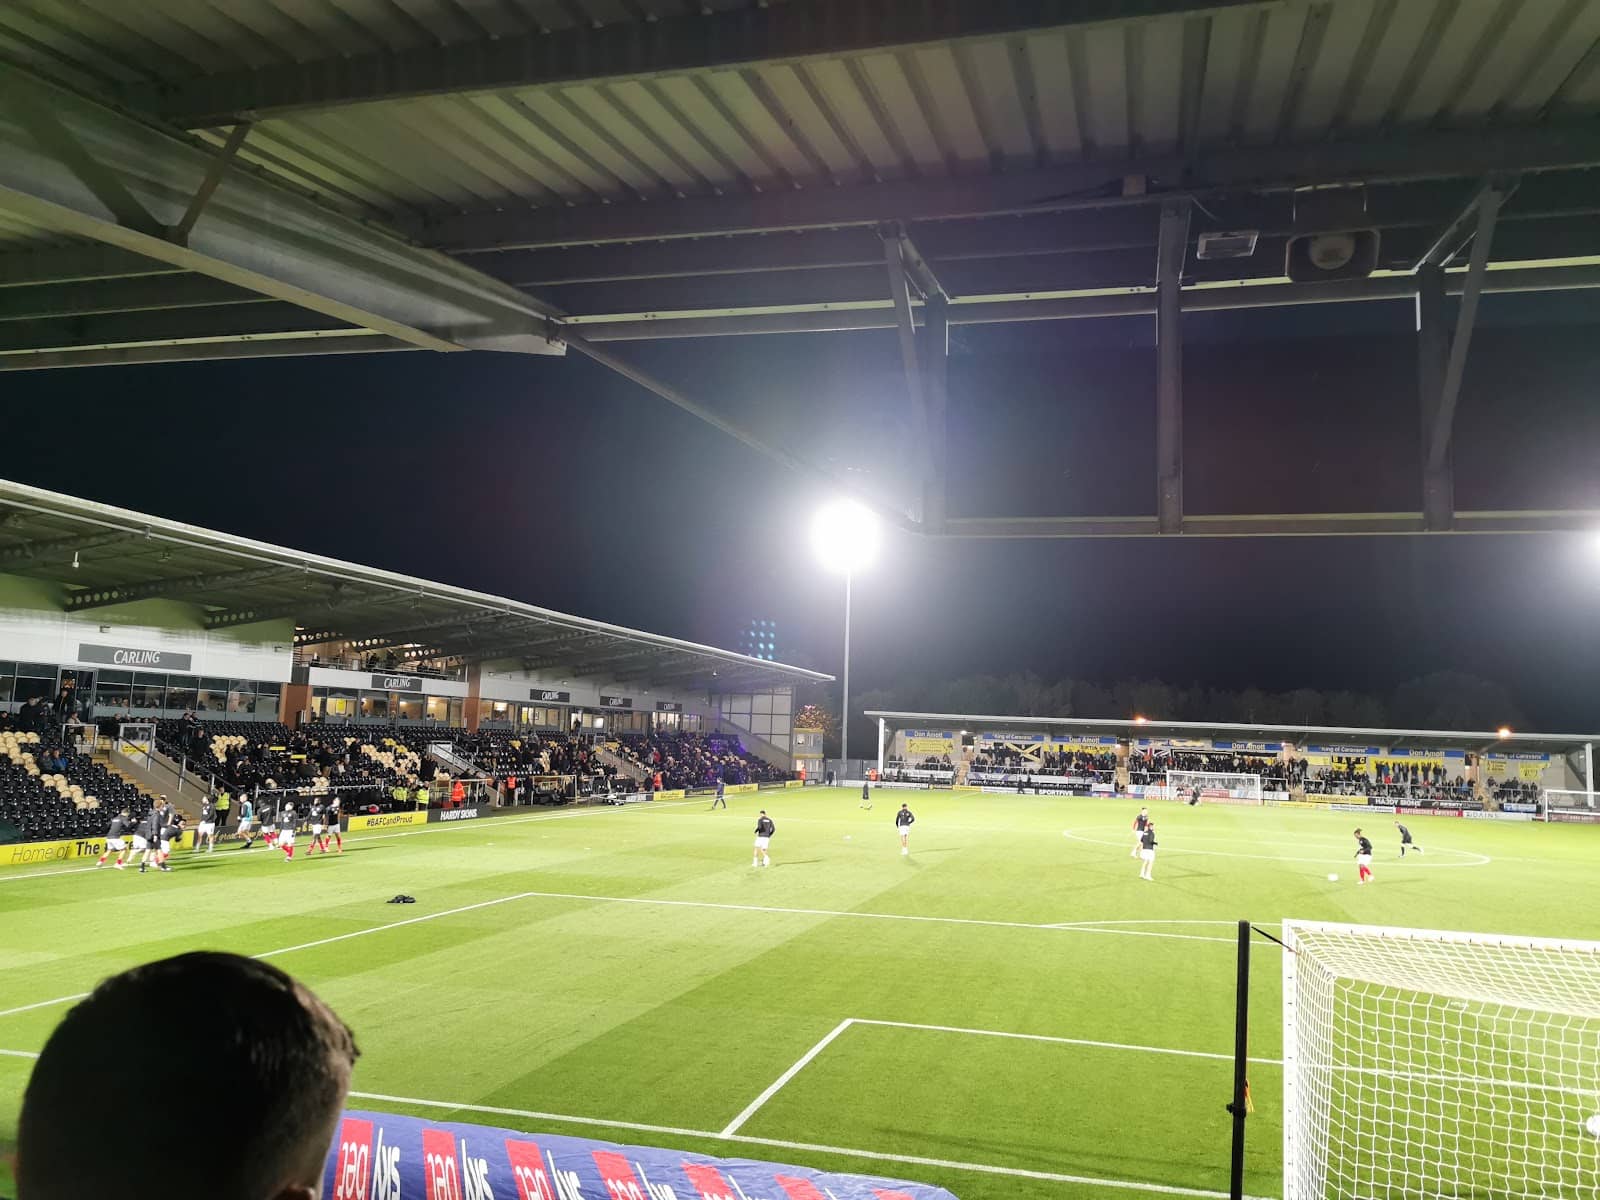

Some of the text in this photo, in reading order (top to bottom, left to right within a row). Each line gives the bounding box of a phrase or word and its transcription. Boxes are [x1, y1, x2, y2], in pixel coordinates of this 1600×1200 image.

[114, 649, 160, 665] CARLING
[383, 677, 411, 690] CARLING
[366, 815, 413, 829] #BAFCandProud
[440, 808, 478, 822] HARDY SIGNS
[11, 844, 54, 863] Home
[57, 842, 71, 860] of
[76, 841, 100, 857] The
[336, 1127, 401, 1200] sky bet
